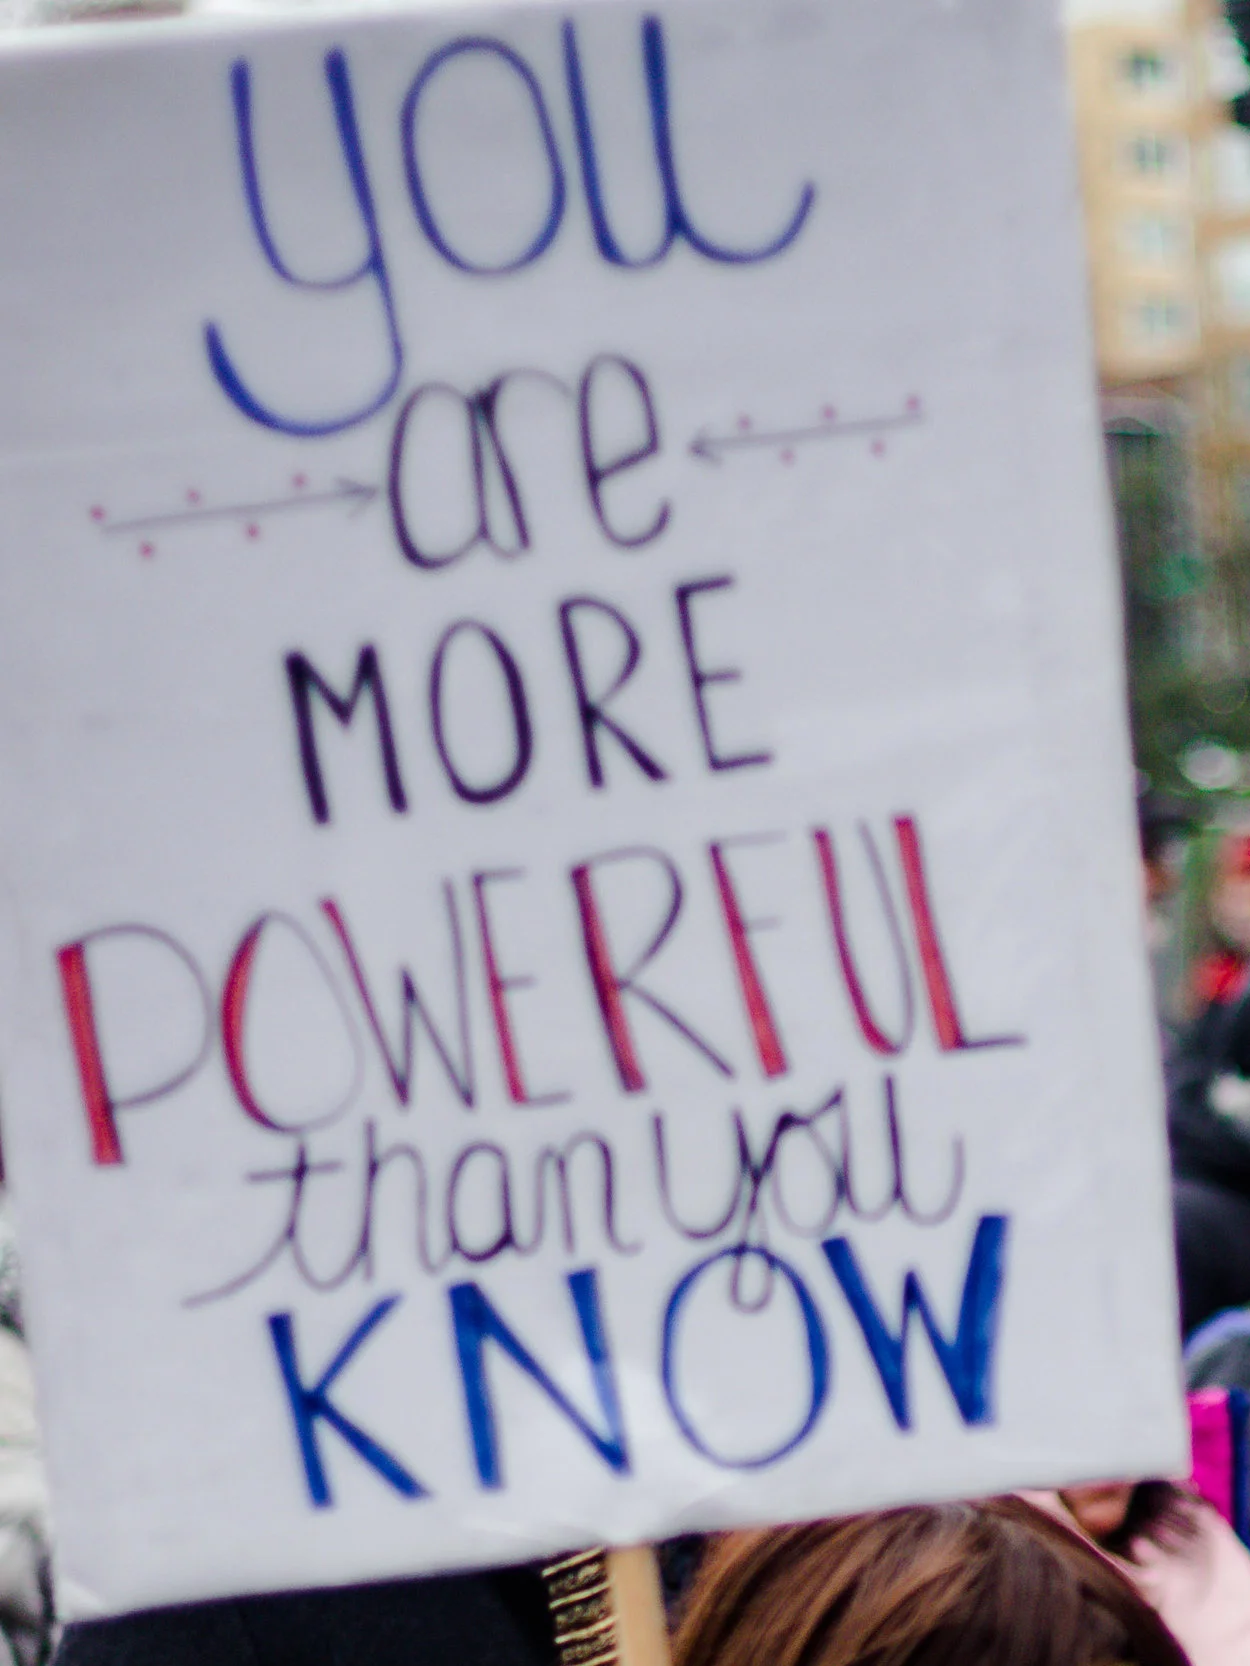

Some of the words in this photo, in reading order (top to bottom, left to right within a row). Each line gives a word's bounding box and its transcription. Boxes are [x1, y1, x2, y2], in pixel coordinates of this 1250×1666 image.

[388, 353, 672, 571] are
[283, 574, 774, 828] MORE
[55, 812, 1028, 1168] POWERFUL
[182, 1118, 641, 1308] than
[650, 1072, 965, 1313] you
[266, 1212, 1012, 1511] KNOW
